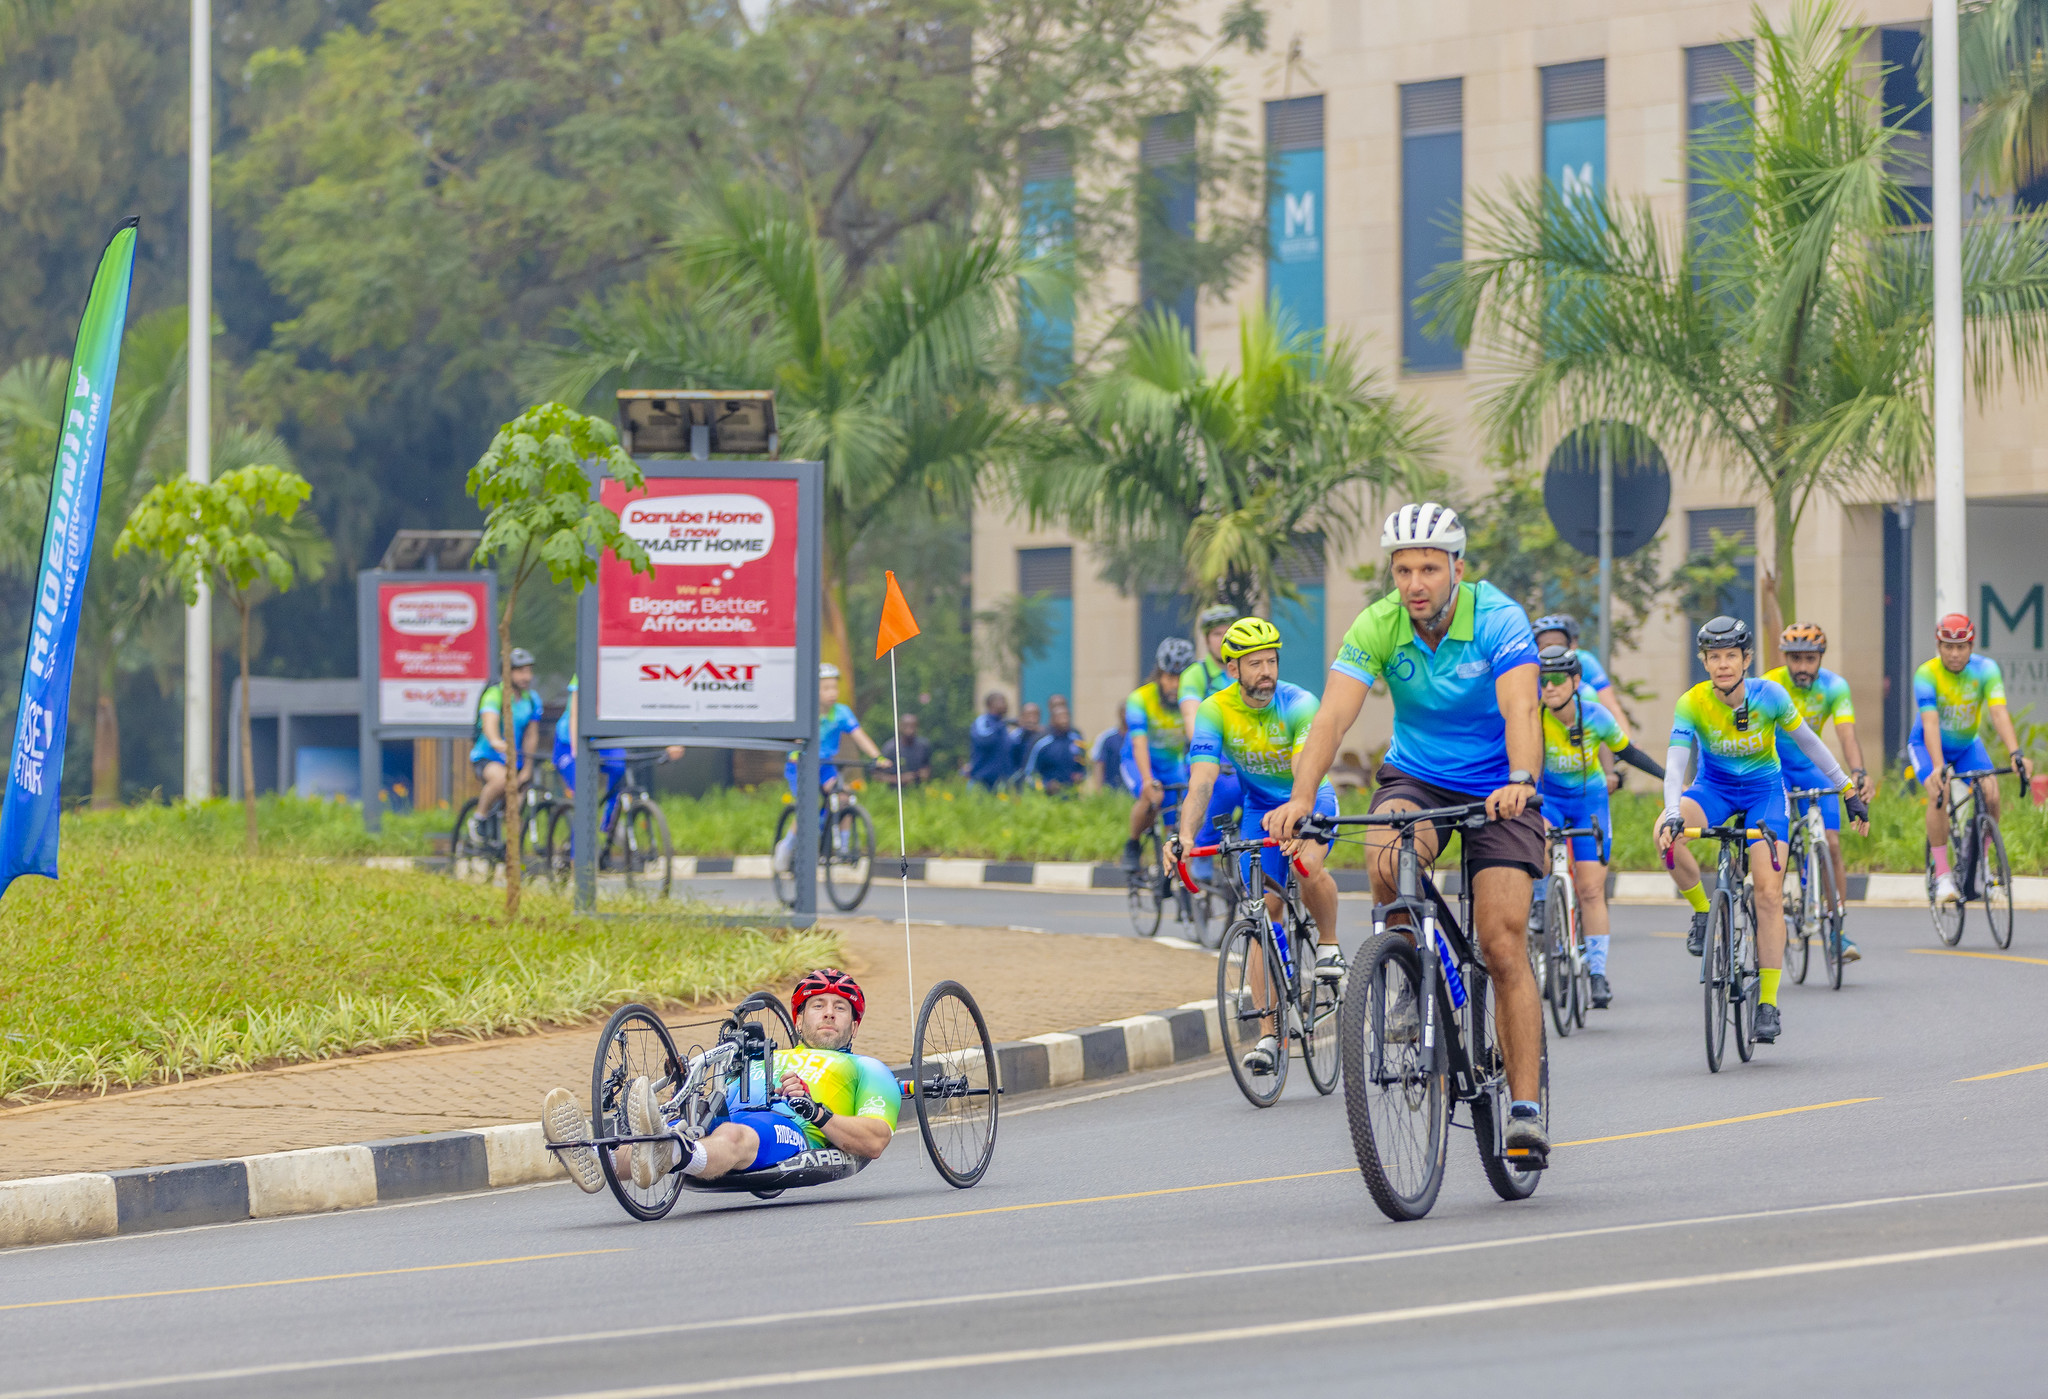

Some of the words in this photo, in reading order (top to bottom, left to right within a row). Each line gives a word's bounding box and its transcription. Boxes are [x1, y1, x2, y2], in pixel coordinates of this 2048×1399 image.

[1285, 191, 1315, 238] M
[630, 511, 703, 524] Danube
[707, 511, 763, 524] Home
[669, 527, 681, 538] is
[684, 528, 720, 538] now
[704, 539, 764, 552] HOME
[676, 585, 698, 595] We
[629, 597, 699, 615] Bigger,
[701, 597, 769, 615] Better,
[641, 616, 757, 632] Affordable.
[1981, 584, 2044, 650] M
[640, 659, 761, 686] SMART
[692, 682, 755, 691] HOME
[1722, 731, 1764, 753] RISE!
[777, 1149, 856, 1172] CARBID
